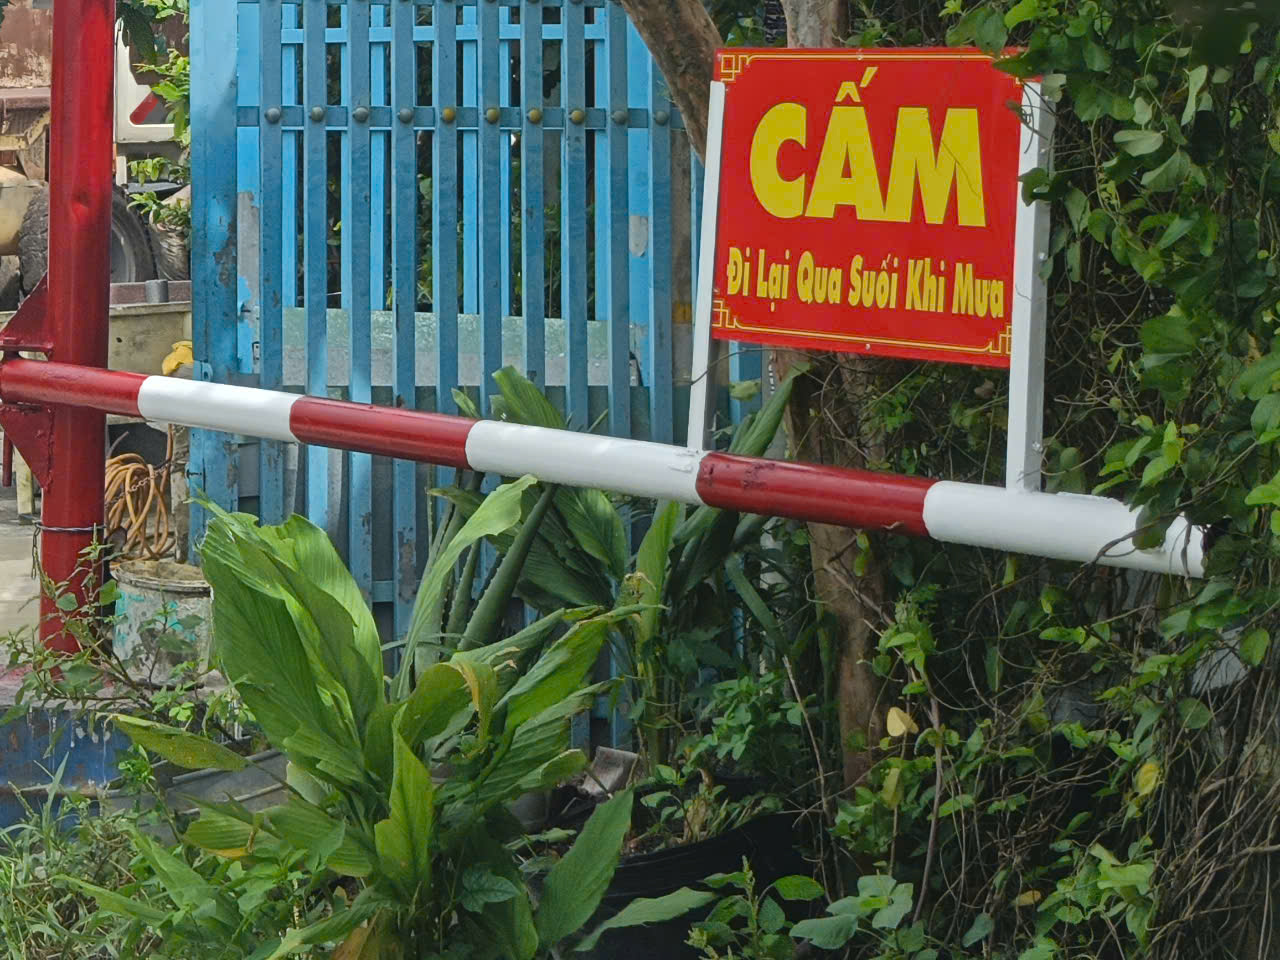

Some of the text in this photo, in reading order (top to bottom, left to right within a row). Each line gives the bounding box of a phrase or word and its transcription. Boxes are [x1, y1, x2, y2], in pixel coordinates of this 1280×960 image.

[749, 66, 987, 228] CẤM
[726, 247, 1005, 319] Đi Lại Qua Suối Khi Mưa
